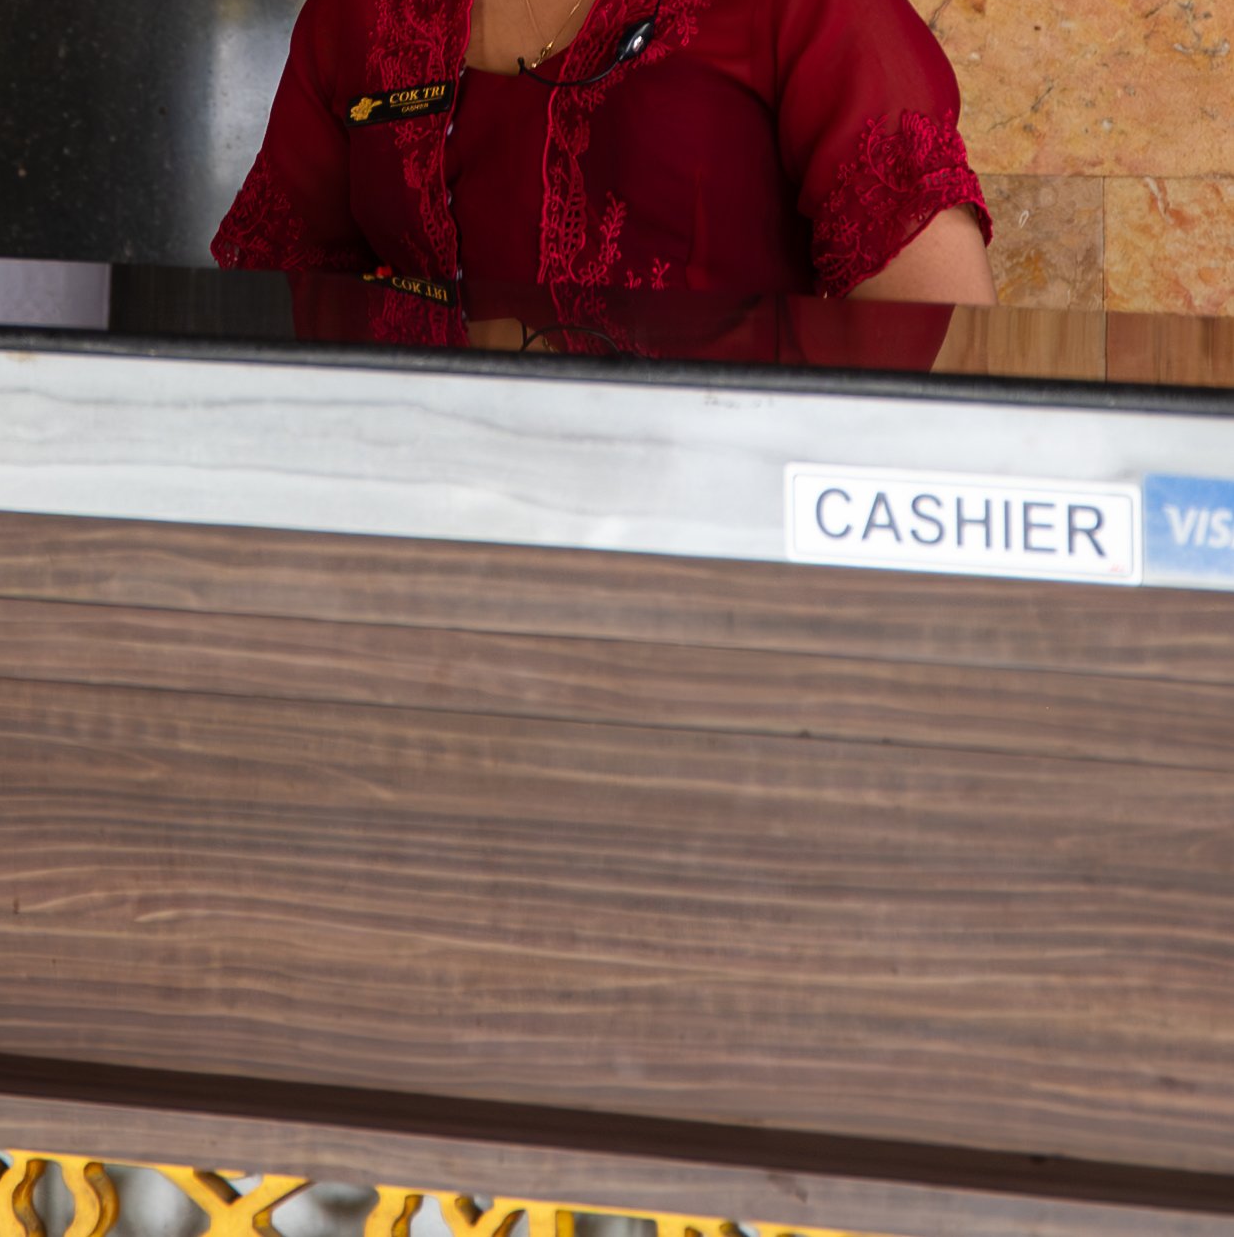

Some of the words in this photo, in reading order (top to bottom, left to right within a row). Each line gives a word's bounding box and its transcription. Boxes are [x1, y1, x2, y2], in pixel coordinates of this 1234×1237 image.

[389, 90, 419, 104] COK
[422, 84, 446, 99] TRI
[816, 487, 1106, 558] CASHIER
[1163, 503, 1234, 549] VIS
